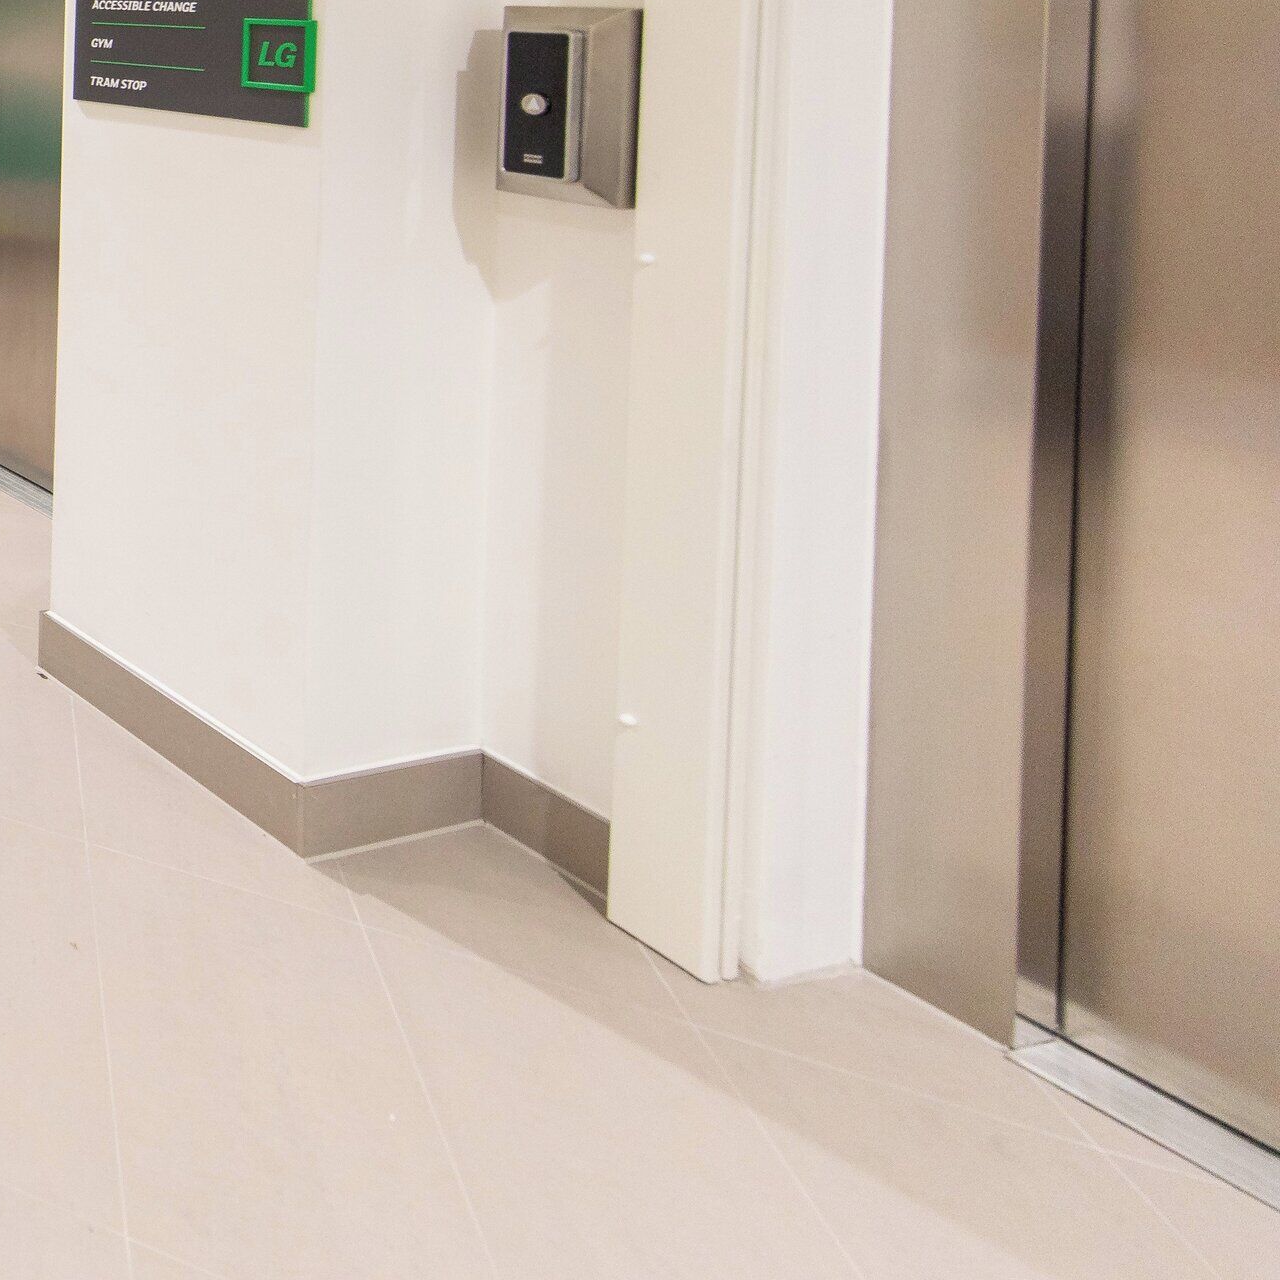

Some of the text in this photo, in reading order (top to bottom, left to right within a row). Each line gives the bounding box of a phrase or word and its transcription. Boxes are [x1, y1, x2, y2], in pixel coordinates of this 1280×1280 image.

[91, 0, 198, 13] ACCESSIBLE CHANGE
[90, 37, 114, 49] GYM
[257, 41, 298, 68] LG
[89, 75, 148, 91] TRAM STOP
